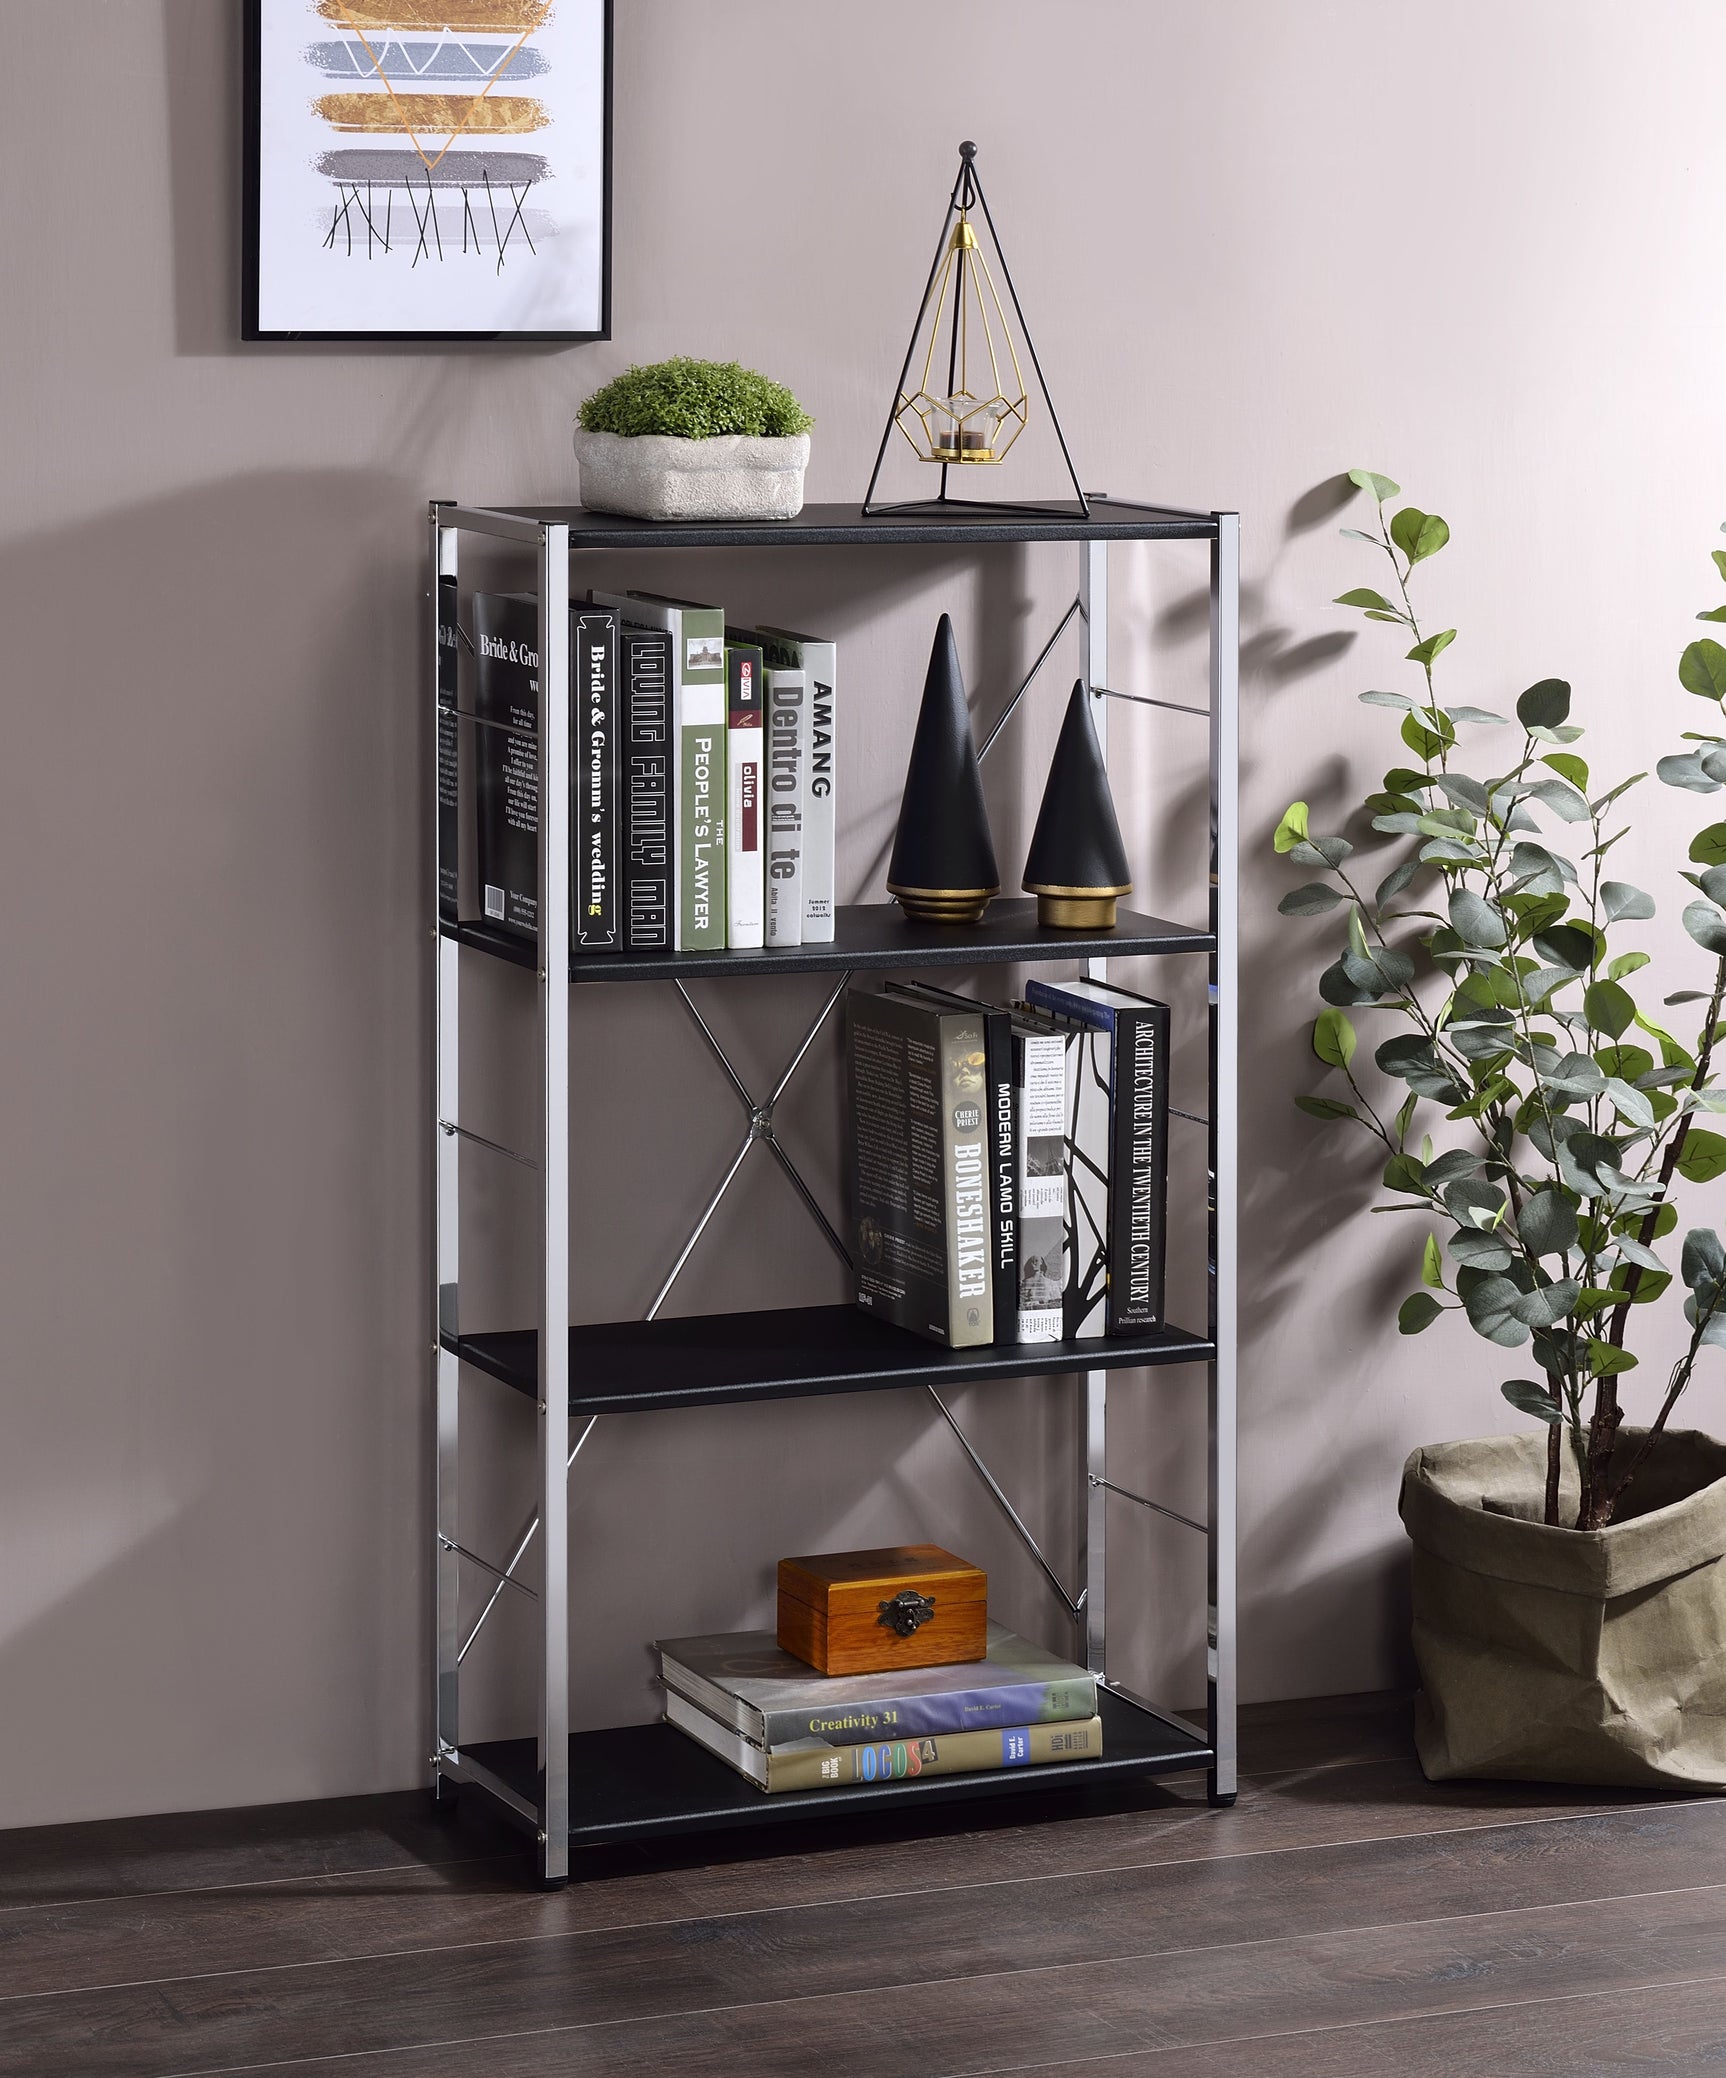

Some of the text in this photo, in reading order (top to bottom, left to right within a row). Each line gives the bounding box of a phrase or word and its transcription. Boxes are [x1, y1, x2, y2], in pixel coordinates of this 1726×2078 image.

[480, 633, 508, 660] Bride
[509, 640, 518, 663] &
[519, 643, 539, 668] Gro
[631, 642, 666, 742] LOVING
[772, 687, 804, 792] Dentro
[812, 680, 832, 798] AMANG
[588, 645, 606, 916] Bride & Gromm's wedding
[743, 766, 756, 808] olivia
[631, 756, 667, 865] FAMILY
[771, 803, 802, 832] di
[694, 737, 712, 930] PEOPLE'S LAWYER
[715, 820, 724, 845] THE
[770, 848, 800, 879] te
[631, 879, 667, 945] MAN
[770, 918, 778, 936] vento
[955, 1109, 979, 1119] CHERIE
[957, 1118, 979, 1127] PRIEST
[998, 1083, 1015, 1269] MODERN LAMO SKILL
[1130, 1021, 1154, 1302] ARCHITECYURE IN THE TWENTIETH CENTURY
[954, 1142, 985, 1298] BONESHAKER
[809, 1711, 898, 1732] Creativity 31
[851, 1740, 937, 1781] LOGOS 4
[1051, 1734, 1063, 1751] HDi
[822, 1762, 830, 1774] BIG
[830, 1757, 839, 1778] BOOK
